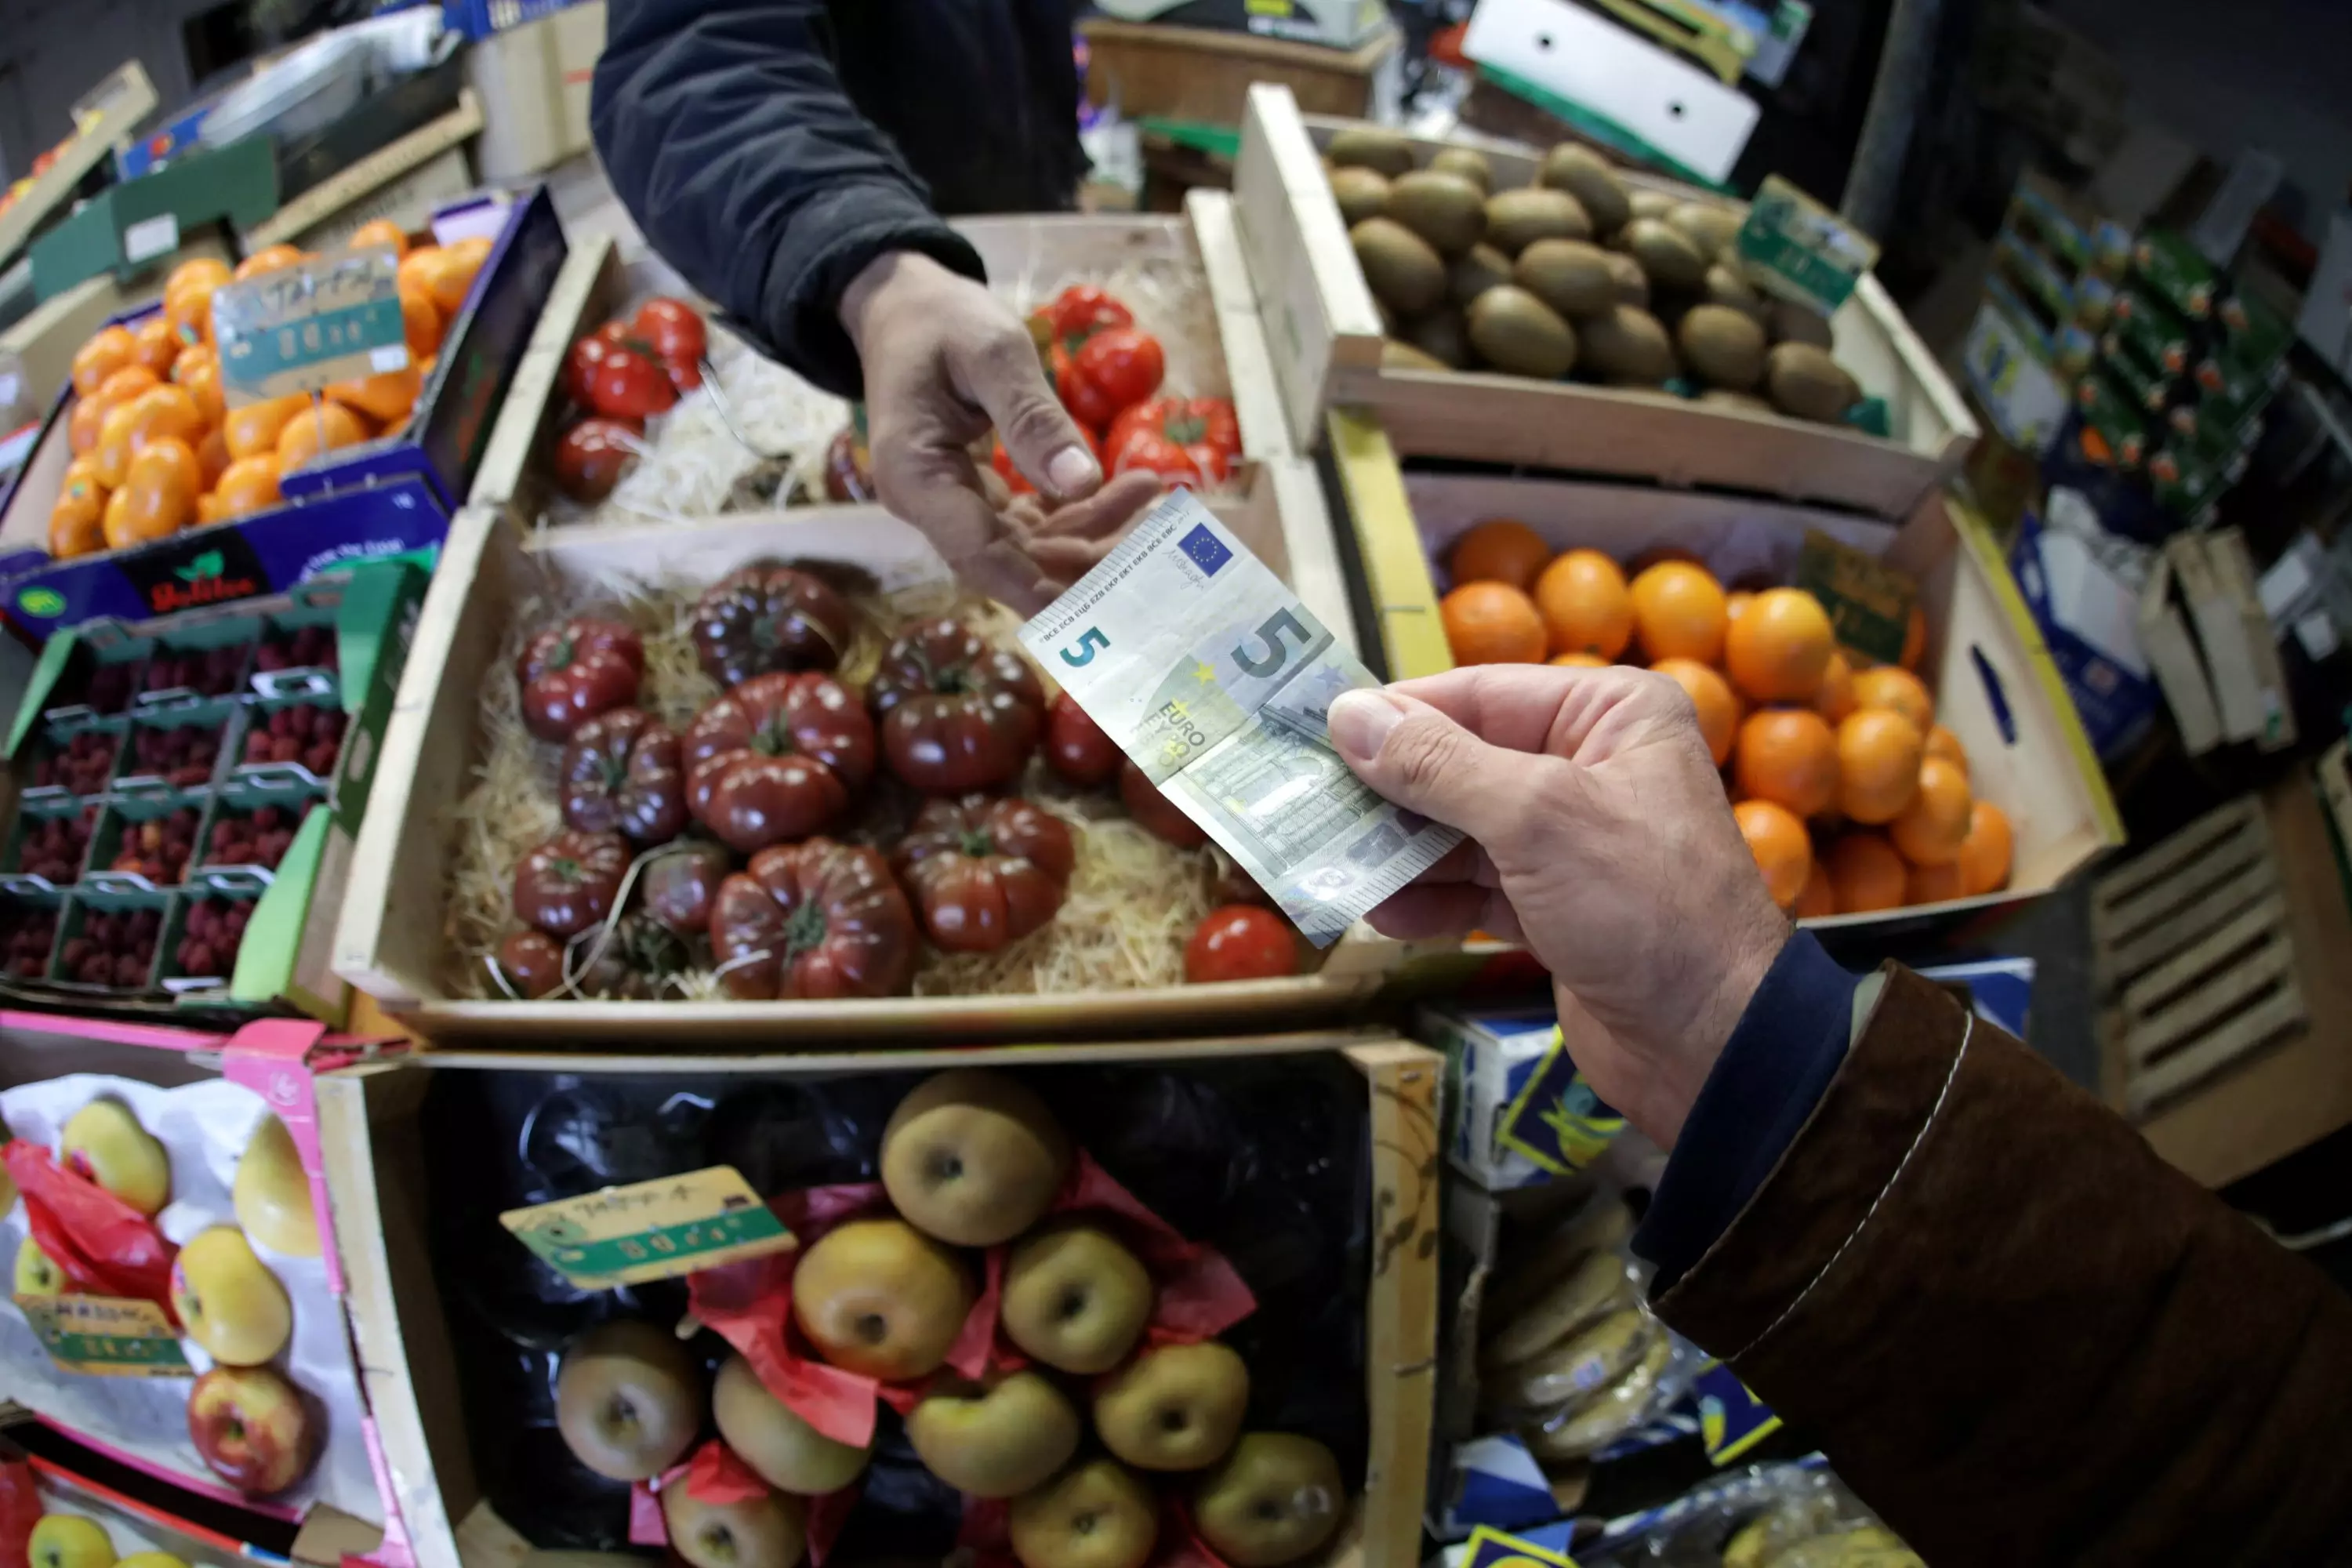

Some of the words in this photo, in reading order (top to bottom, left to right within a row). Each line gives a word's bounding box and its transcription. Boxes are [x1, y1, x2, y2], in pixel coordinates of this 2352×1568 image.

[1059, 615, 1075, 630] ECB
[1090, 590, 1105, 604] EZB
[1119, 564, 1133, 579] EKT
[1132, 551, 1148, 566] EKB
[1162, 524, 1177, 539] EBC
[1059, 626, 1110, 667] 5
[1230, 606, 1312, 678] 5
[1159, 701, 1205, 746] EURO
